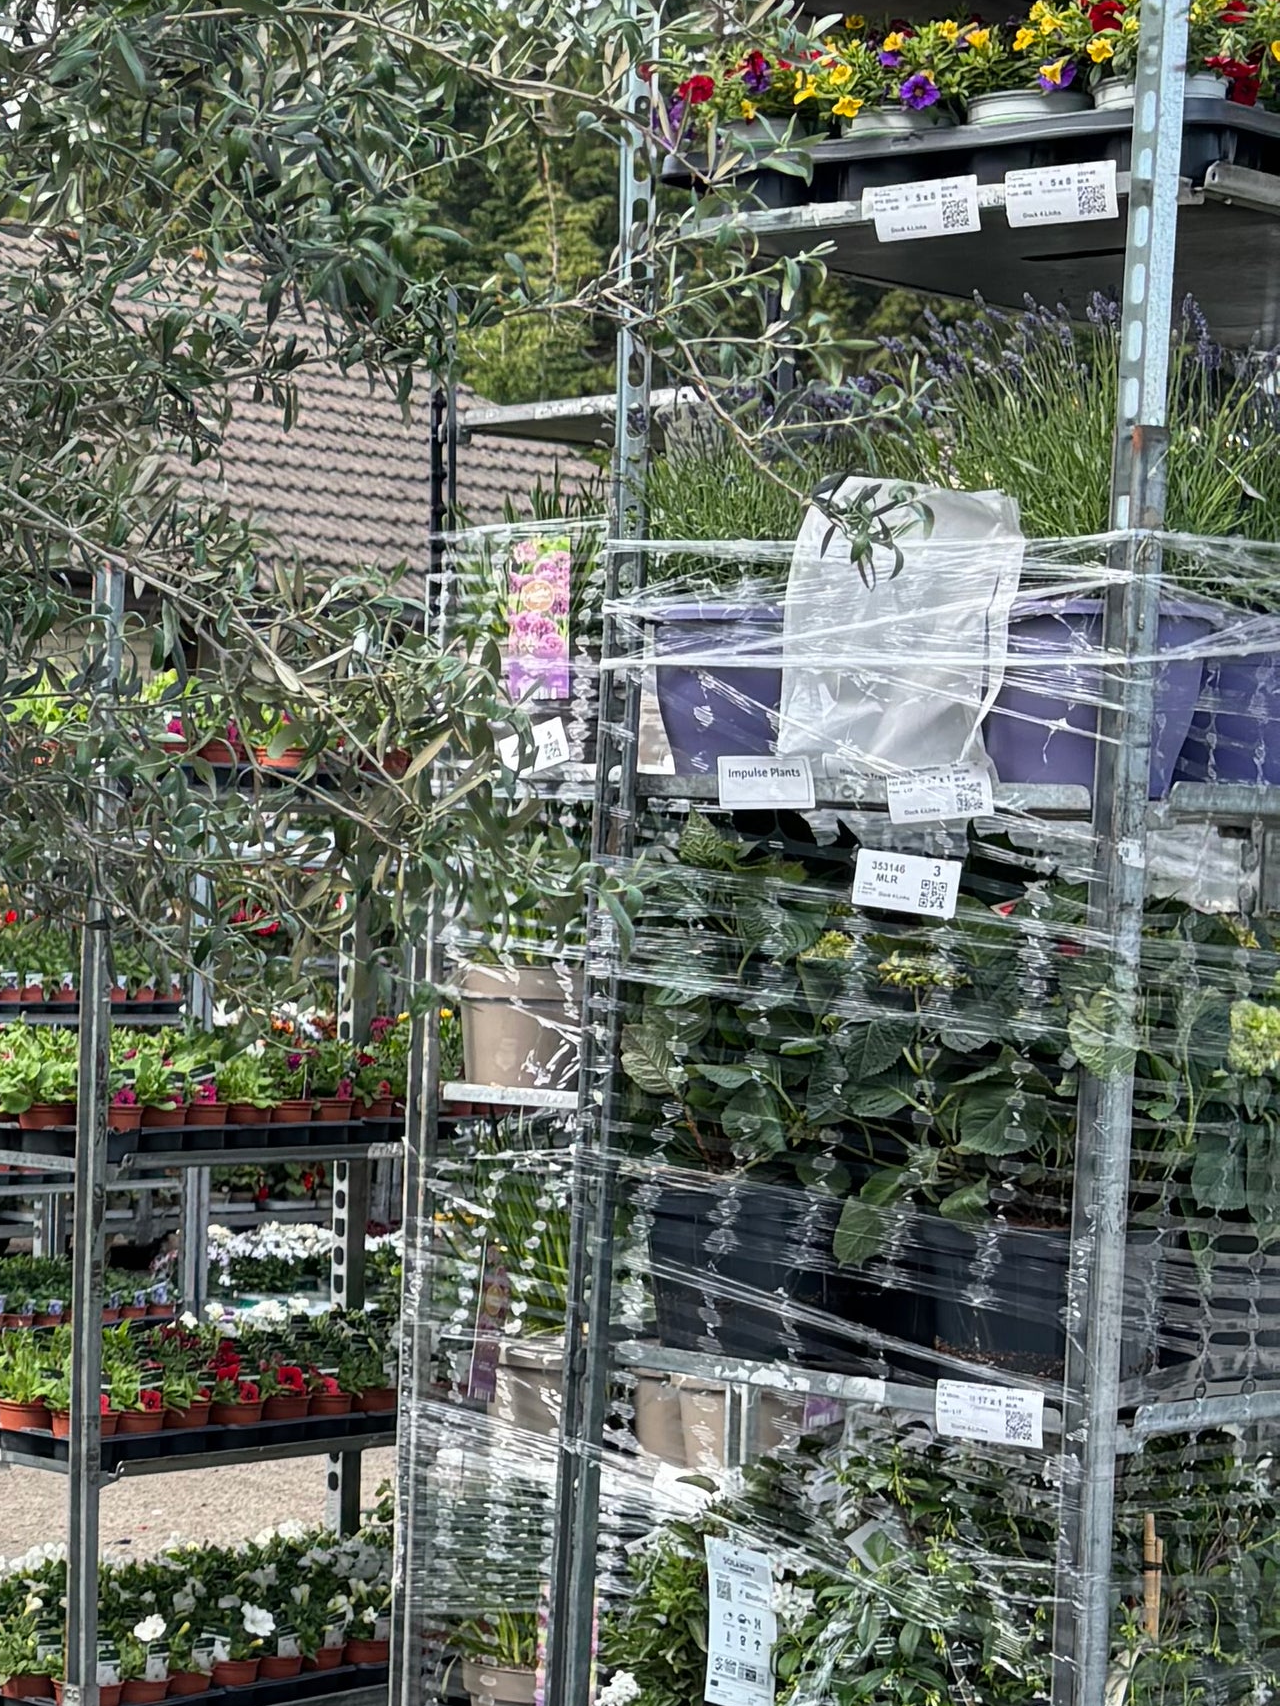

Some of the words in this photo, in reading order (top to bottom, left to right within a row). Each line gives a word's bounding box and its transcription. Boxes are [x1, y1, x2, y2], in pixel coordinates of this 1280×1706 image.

[728, 767, 768, 780] Impulse
[770, 768, 801, 778] Plants
[871, 861, 906, 874] 353146
[933, 865, 941, 877] 3
[876, 873, 898, 884] MLR
